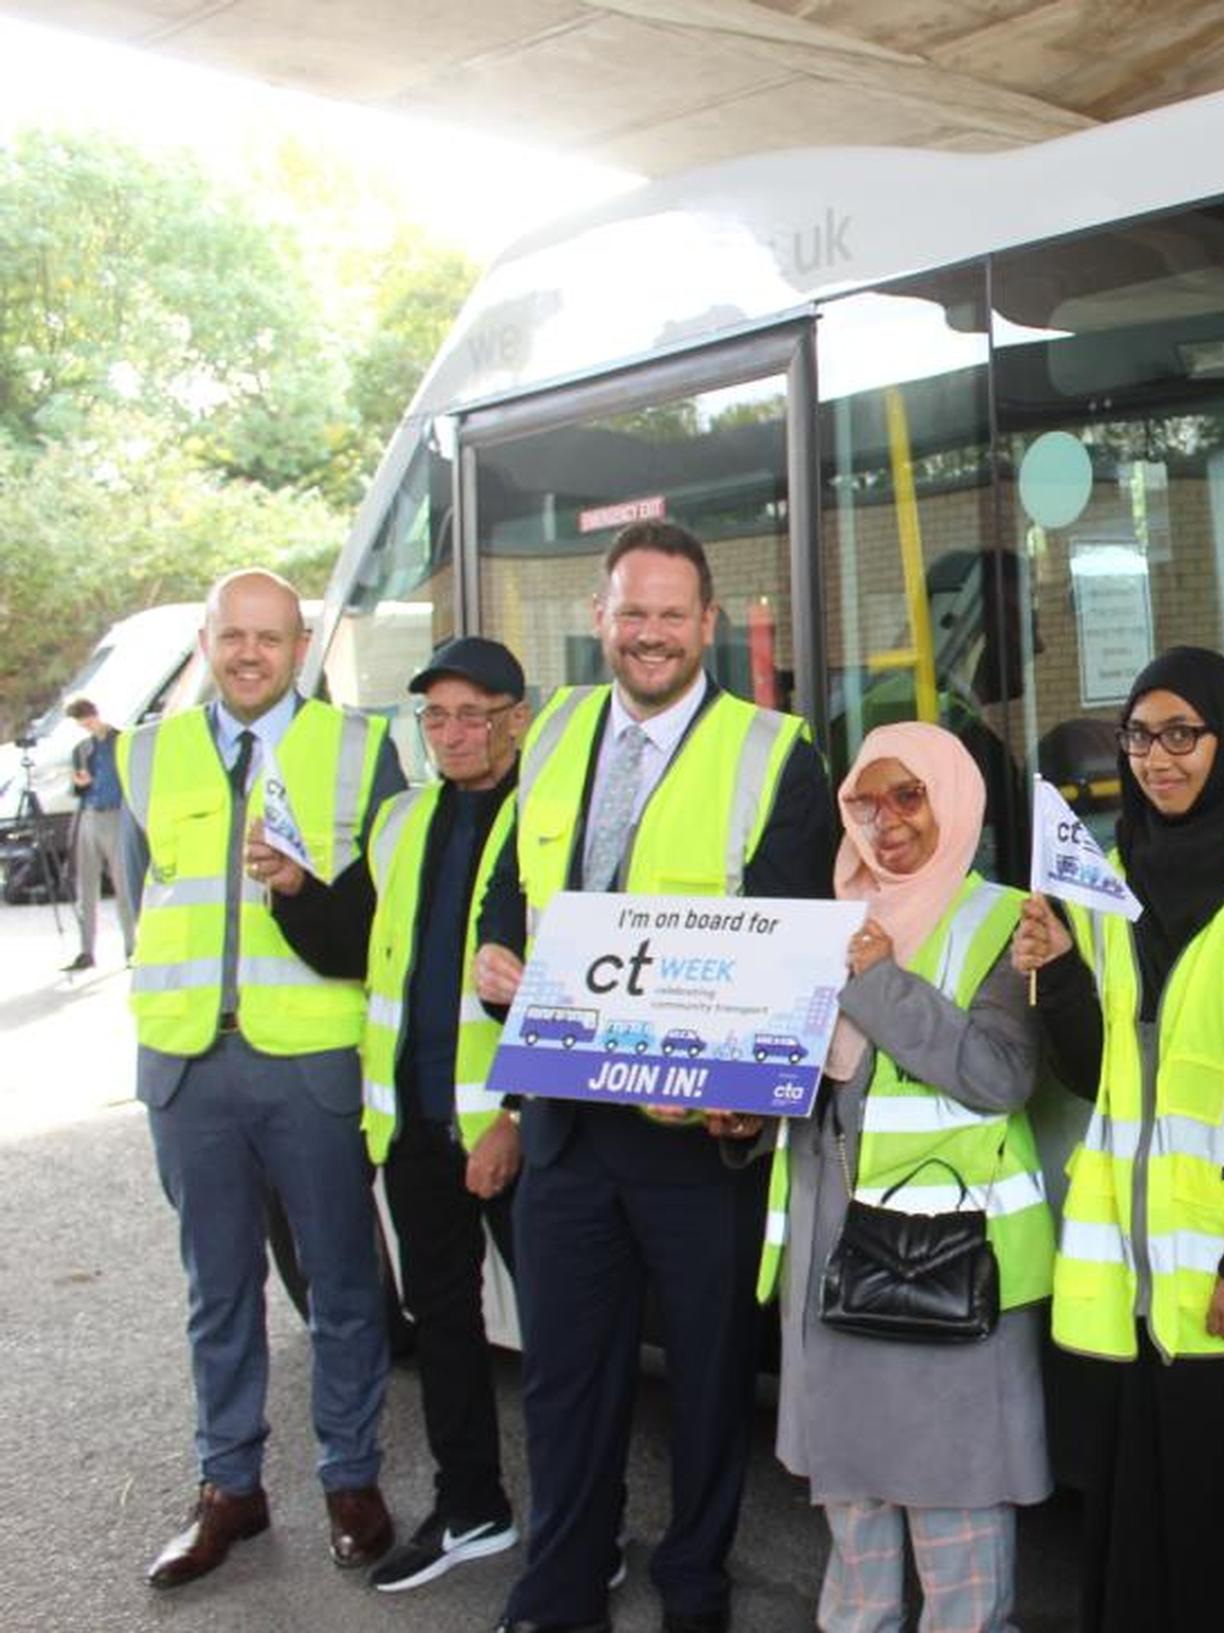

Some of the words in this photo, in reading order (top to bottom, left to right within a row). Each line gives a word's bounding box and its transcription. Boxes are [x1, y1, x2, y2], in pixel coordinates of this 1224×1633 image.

[618, 909, 651, 929] I'm
[655, 911, 680, 929] on
[684, 909, 745, 932] board
[749, 912, 781, 935] for
[586, 937, 653, 997] ct
[660, 957, 736, 983] WEEK
[588, 1061, 661, 1094] JOIN
[662, 1066, 709, 1098] IN!
[773, 1082, 804, 1100] cta
